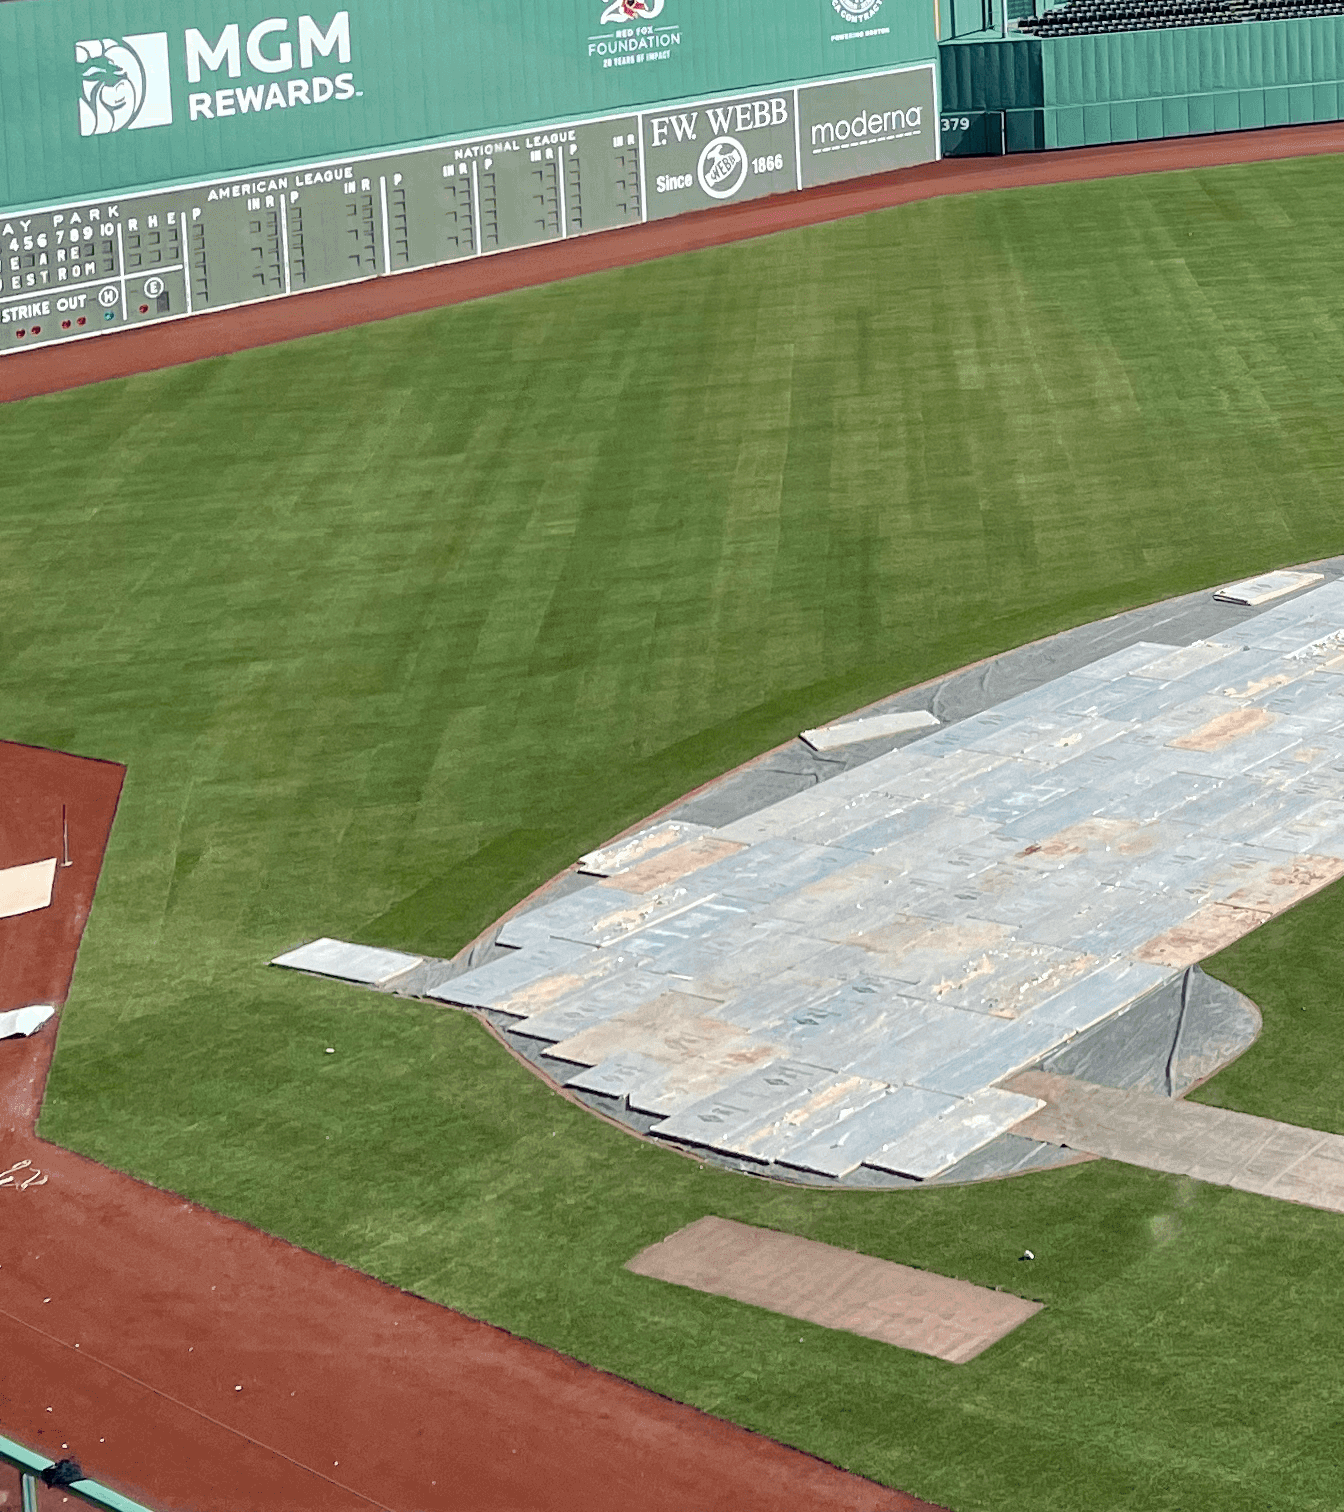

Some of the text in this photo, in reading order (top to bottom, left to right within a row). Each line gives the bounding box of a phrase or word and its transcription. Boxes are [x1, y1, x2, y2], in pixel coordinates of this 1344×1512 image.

[184, 11, 351, 83] MGM
[588, 32, 681, 57] FOUNDATION
[188, 73, 355, 121] REWARDS
[650, 97, 789, 147] F.W. WEBB
[811, 106, 920, 145] moderna
[941, 117, 970, 132] 379
[454, 129, 577, 161] NATIONAL LEAGUE
[751, 153, 784, 175] 1866
[207, 166, 353, 202] AMERICAN LEAGUE
[361, 178, 371, 192] R
[393, 172, 403, 186] P
[656, 173, 693, 193] Since
[265, 194, 275, 209] R
[290, 190, 300, 204] P
[53, 205, 120, 228] PARK
[127, 211, 176, 232] R H E
[192, 207, 202, 221] P
[9, 237, 20, 252] 4
[23, 235, 34, 251] 5
[36, 233, 48, 248] 6
[55, 229, 65, 245] 7
[82, 225, 94, 241] 9
[99, 222, 115, 237] 10
[1, 293, 88, 324] STRIKE OUT
